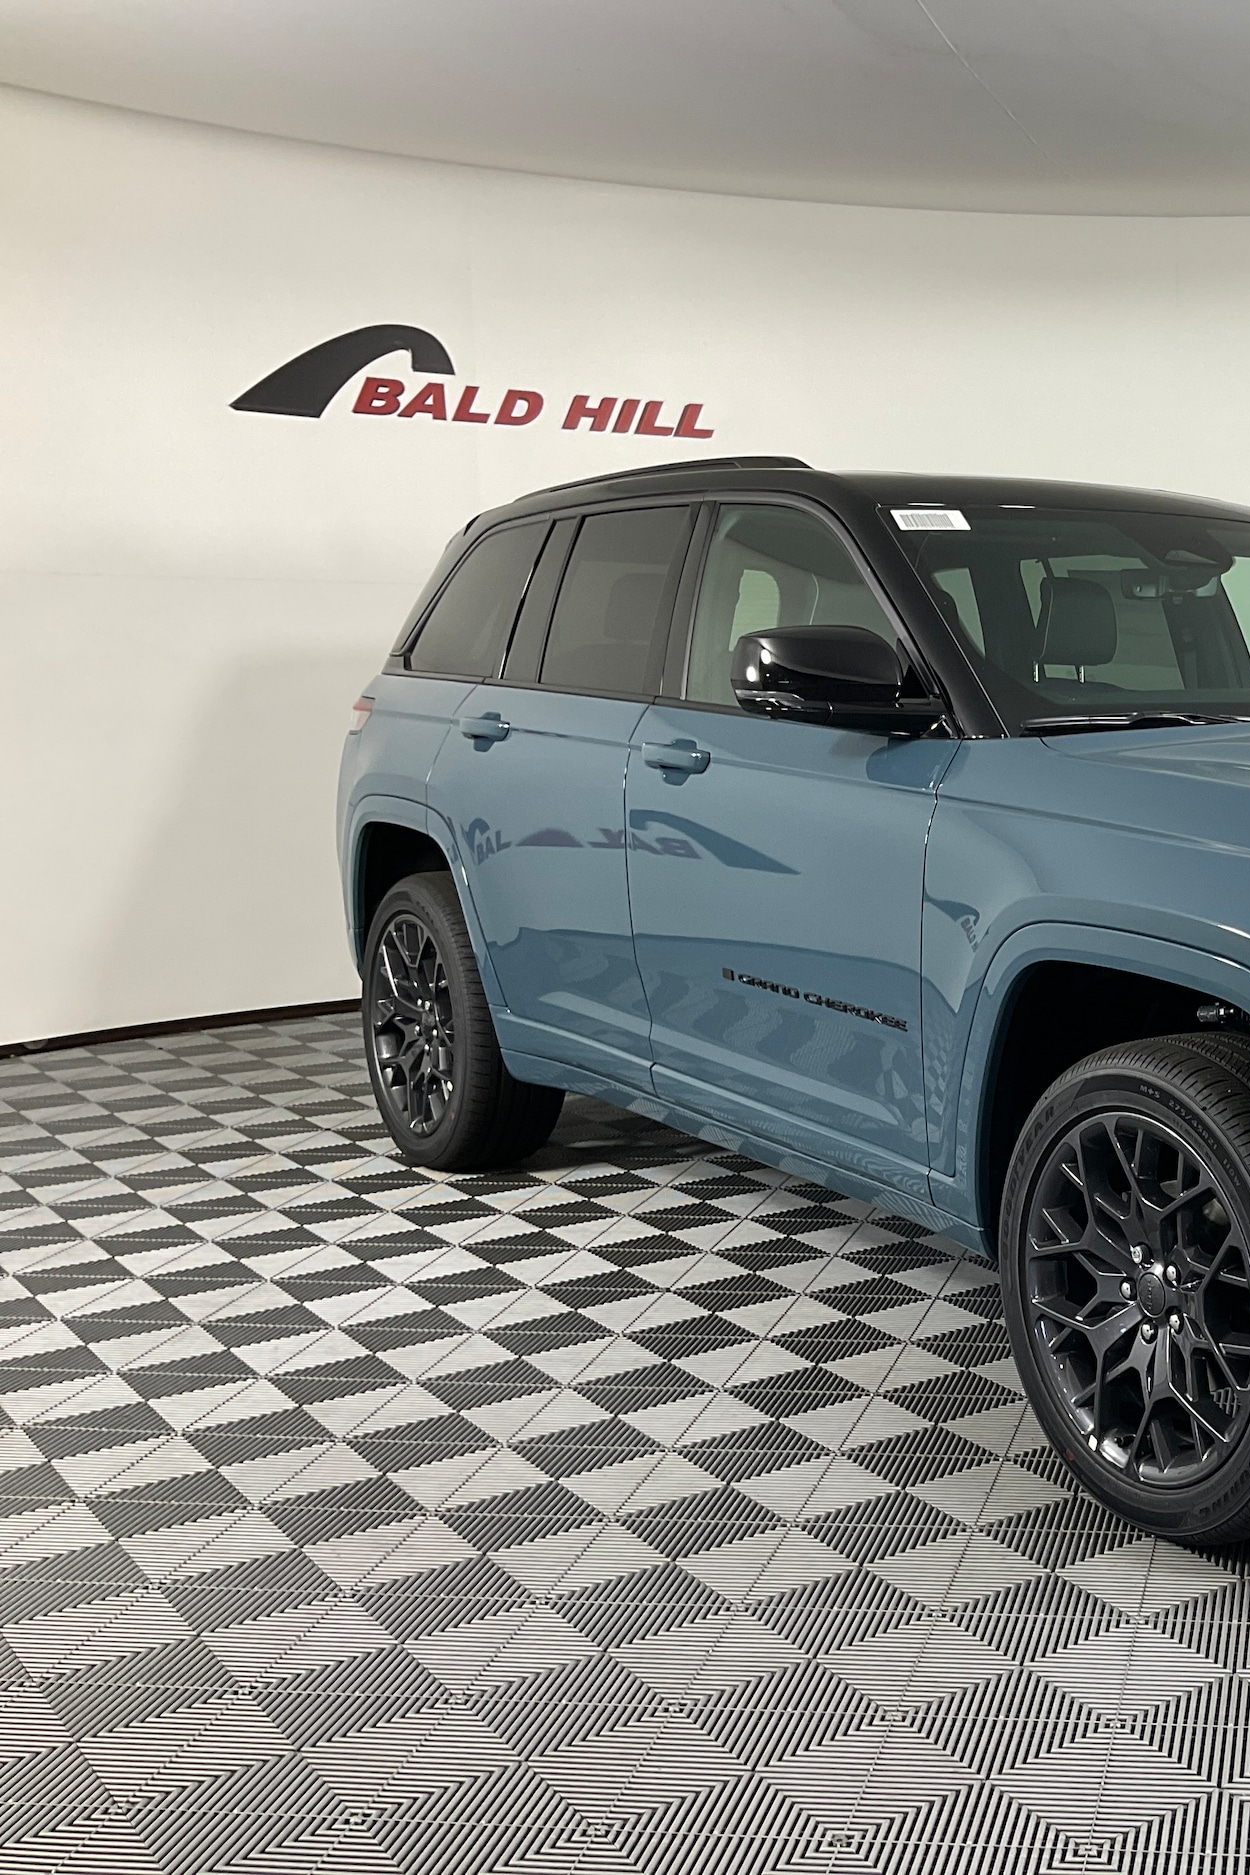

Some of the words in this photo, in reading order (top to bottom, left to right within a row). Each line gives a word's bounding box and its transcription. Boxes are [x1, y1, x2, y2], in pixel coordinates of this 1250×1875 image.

[352, 376, 544, 426] BALD
[561, 395, 715, 439] HILL
[738, 973, 800, 999] GRAND
[803, 992, 909, 1032] CHEROKEE
[1001, 1106, 1055, 1262] GOODYEAR
